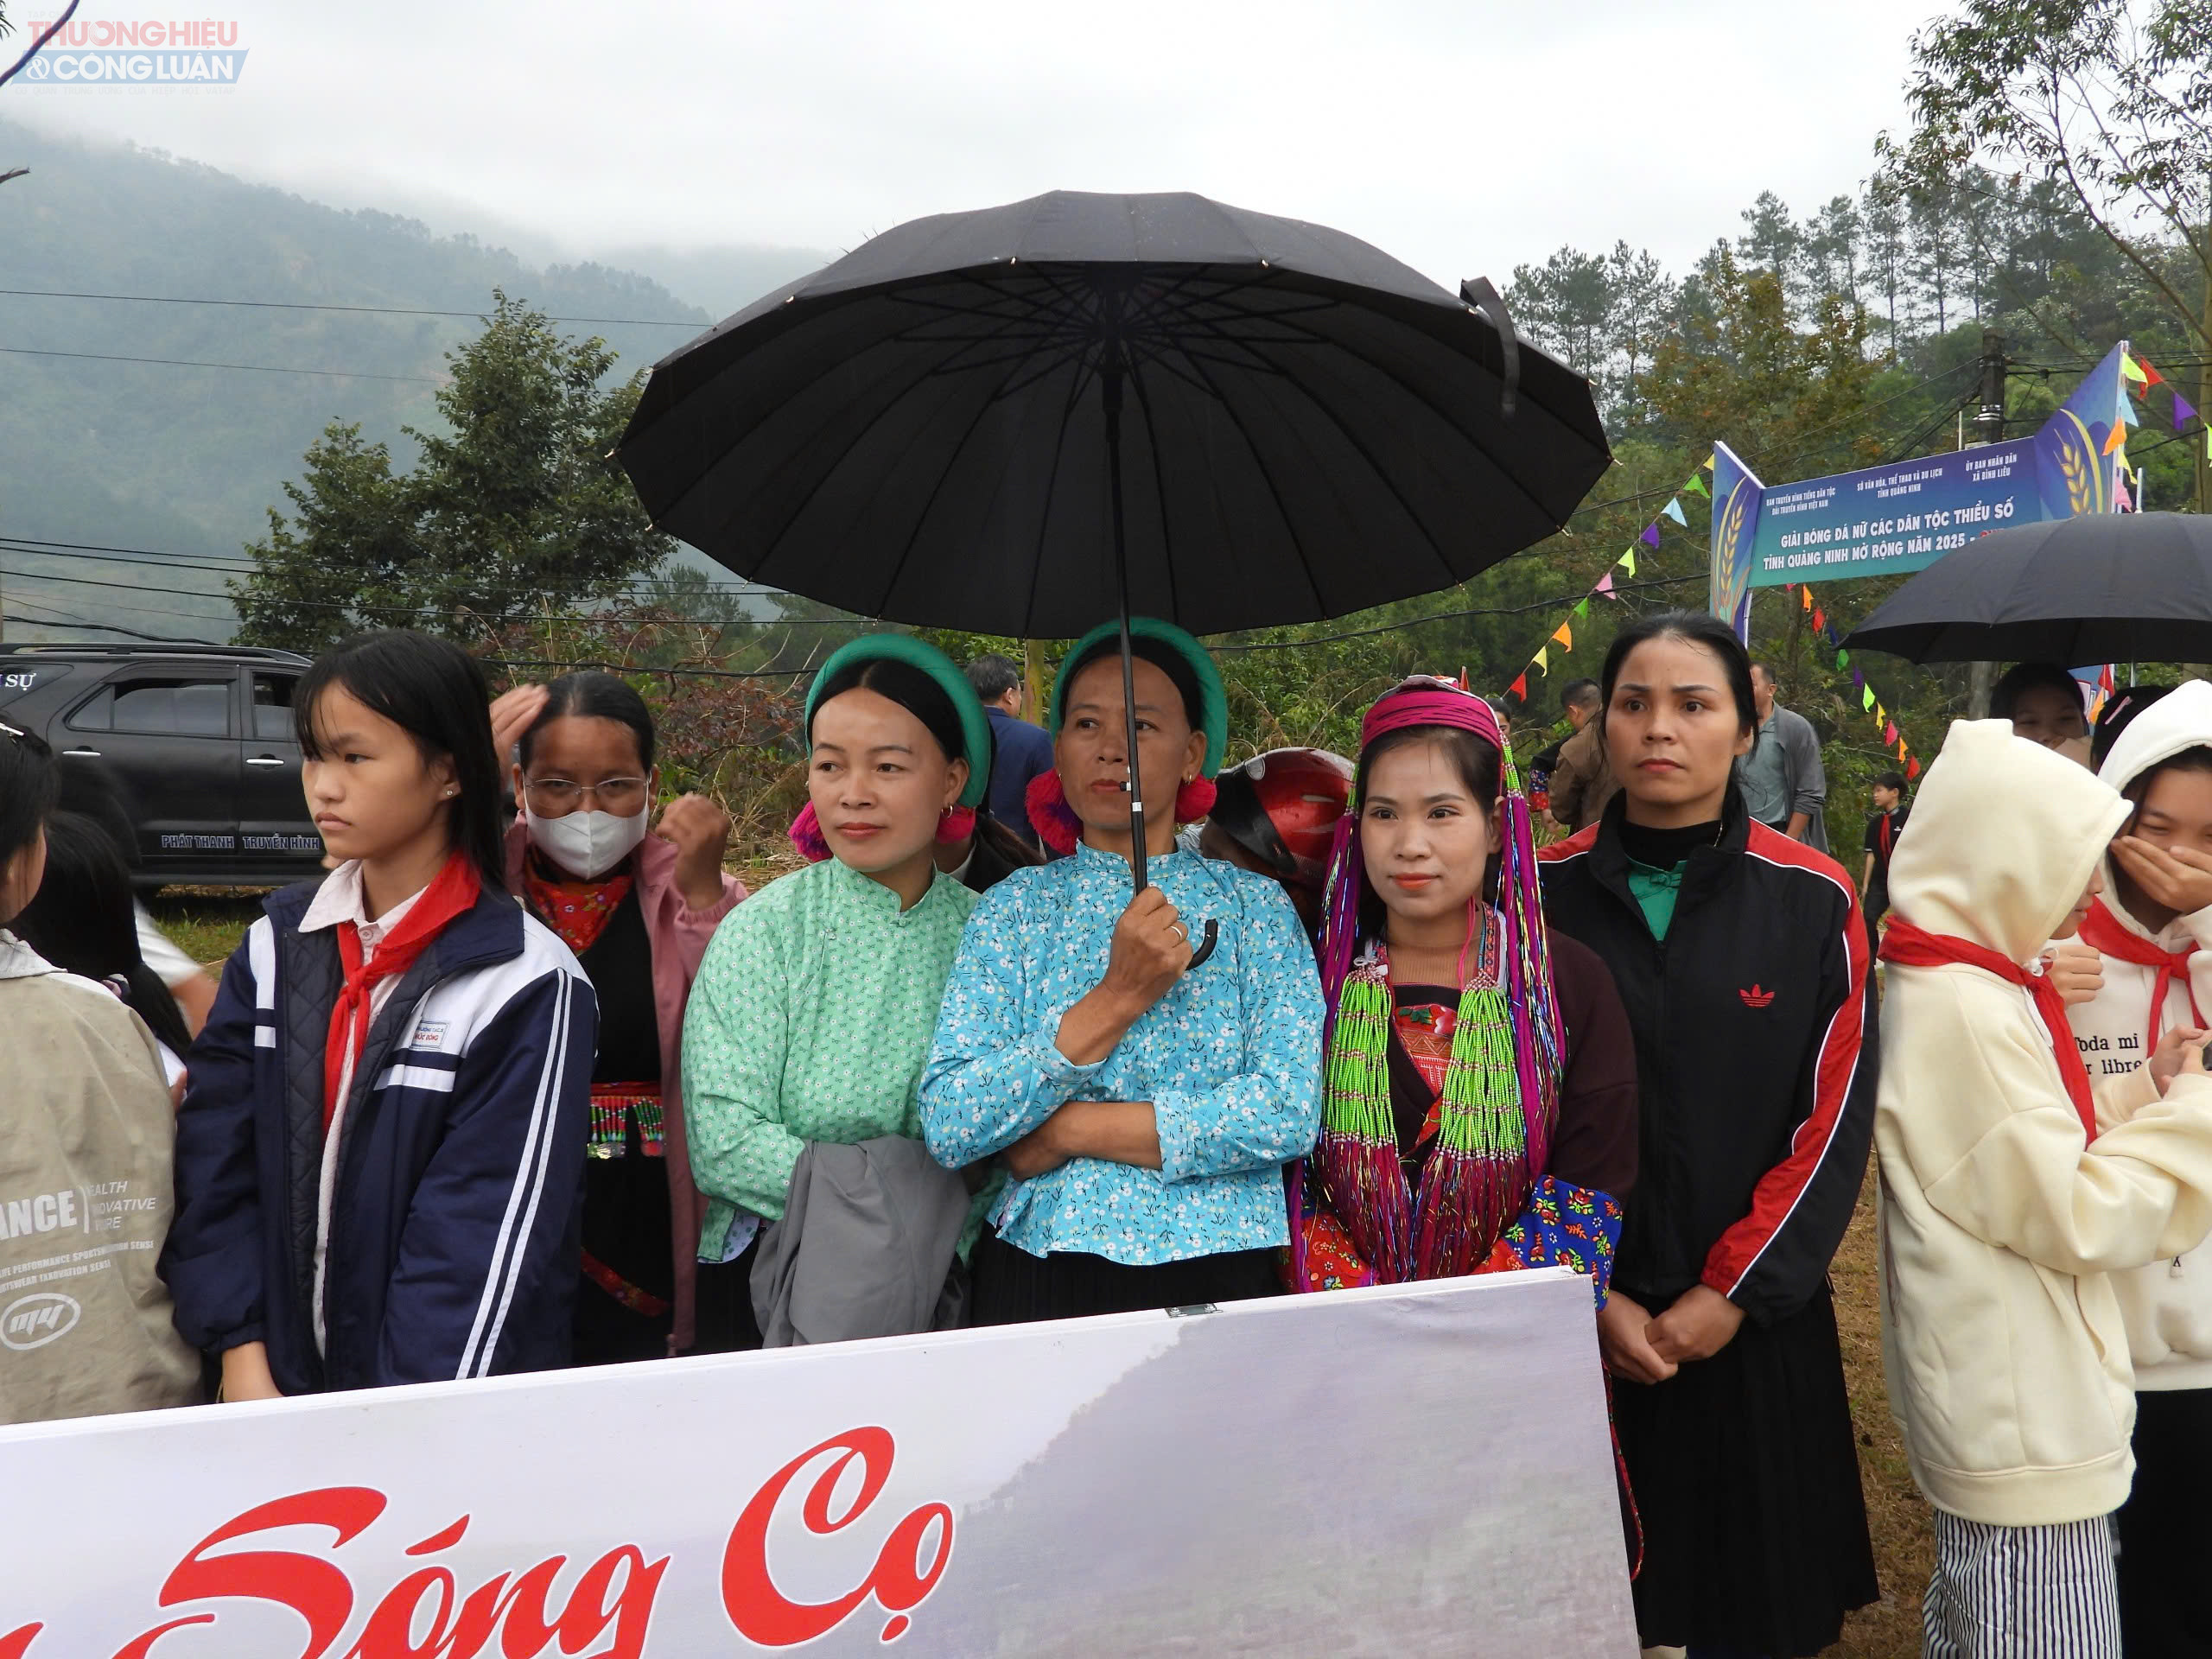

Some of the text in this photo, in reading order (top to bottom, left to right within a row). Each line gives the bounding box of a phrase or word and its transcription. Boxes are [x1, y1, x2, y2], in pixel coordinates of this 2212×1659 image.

[1803, 528, 1831, 545] BÓNG
[1853, 521, 1868, 539] NỮ
[1870, 518, 1893, 537] CÁC
[1897, 514, 1921, 532] DÂN
[1924, 510, 1950, 531] TỘC
[1954, 500, 1990, 524] THIỂU
[1994, 496, 2014, 519] SỐ
[1824, 549, 1848, 563] NINH
[1852, 543, 1869, 561] MỞ
[1872, 540, 1904, 560] RỘNG
[1907, 535, 1932, 554] NĂM
[1936, 532, 1965, 550] 2025
[194, 836, 235, 849] THANH
[243, 833, 289, 849] TRUYỀN
[290, 835, 320, 850] HÌNH
[2118, 1033, 2139, 1049] mi
[721, 1426, 955, 1646] Cọ
